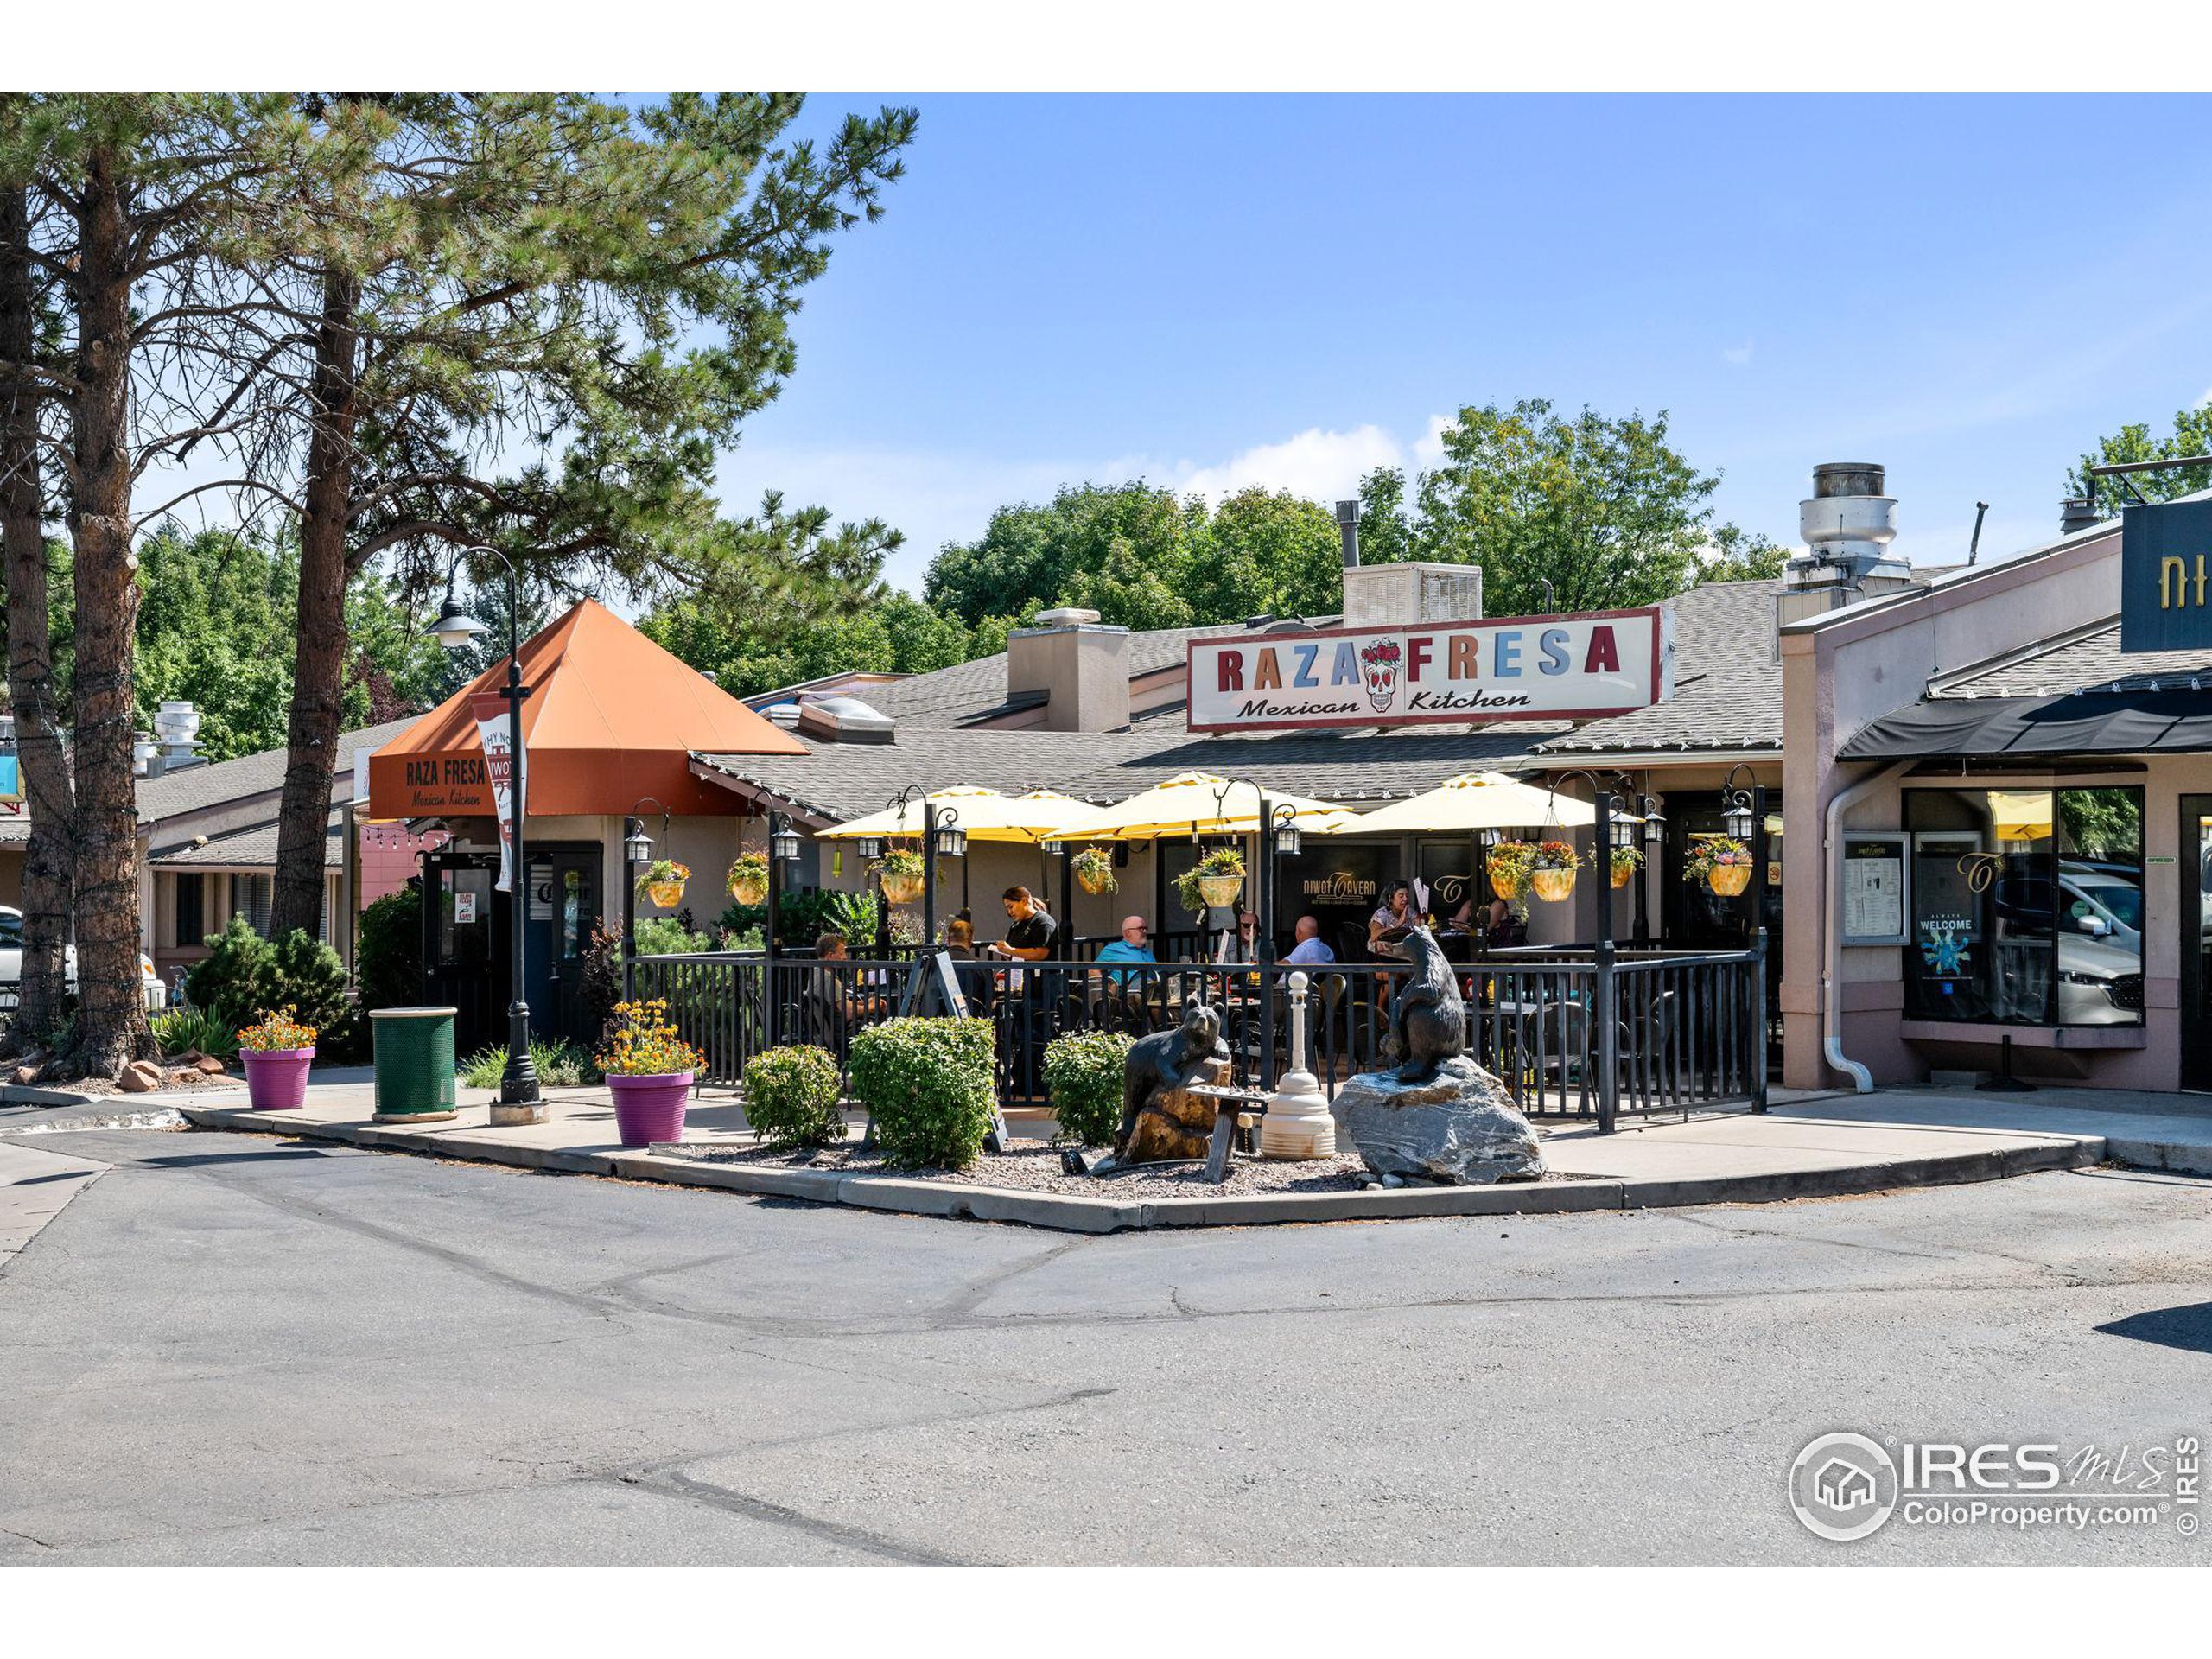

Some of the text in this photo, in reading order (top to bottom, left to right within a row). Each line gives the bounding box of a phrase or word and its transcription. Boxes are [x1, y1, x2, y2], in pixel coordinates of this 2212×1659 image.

[1217, 625, 1621, 692] RAZA FRESA
[1236, 689, 1532, 718] Mexican Kitchen
[499, 732, 511, 745] NO
[406, 759, 485, 785] RAZA FRESA
[411, 790, 446, 807] Mexican
[448, 787, 480, 806] Kitchen
[1303, 872, 1376, 899] NIWOT TAVERN
[1920, 920, 1972, 930] WELCOME
